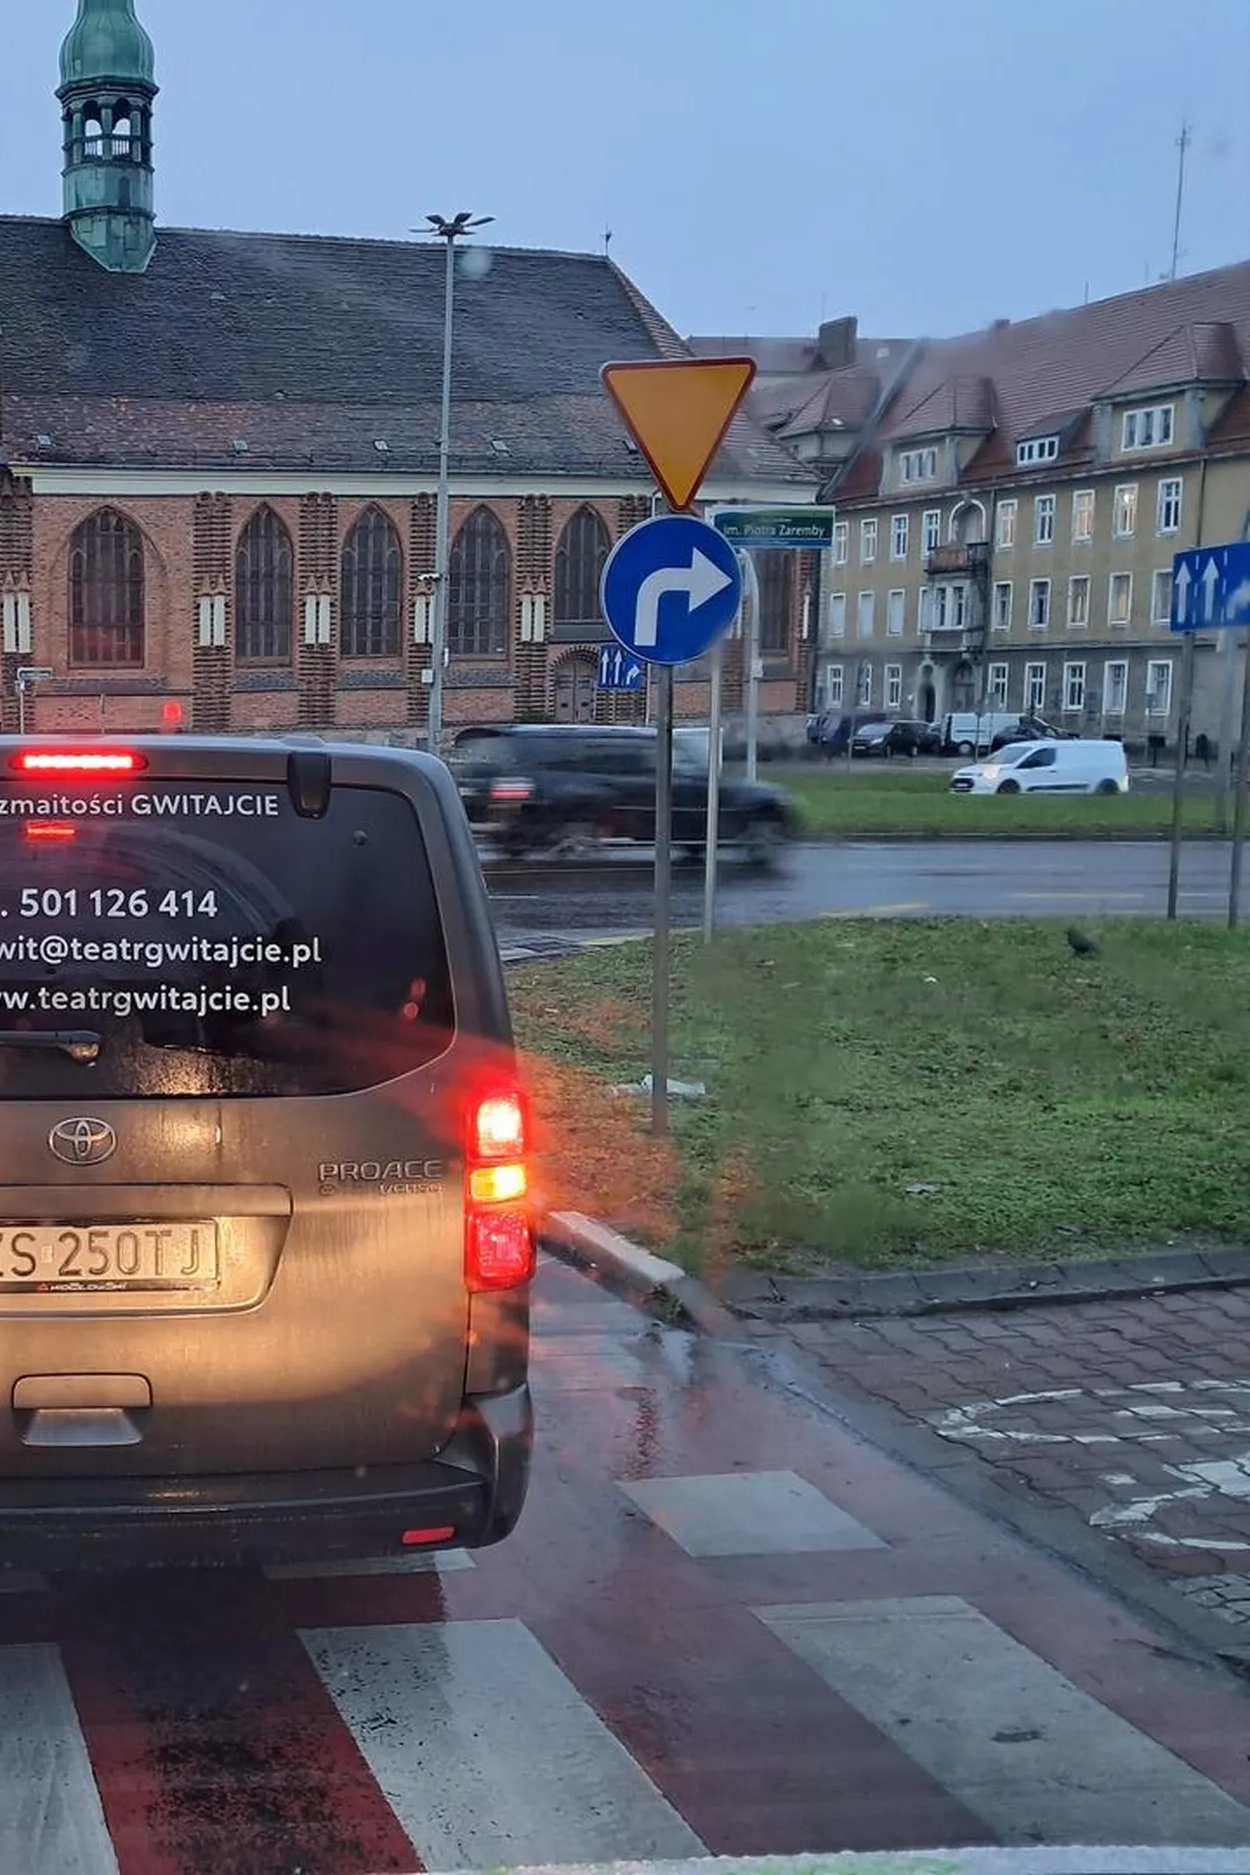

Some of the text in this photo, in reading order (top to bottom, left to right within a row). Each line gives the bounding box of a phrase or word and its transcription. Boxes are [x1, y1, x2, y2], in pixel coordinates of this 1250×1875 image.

[744, 524, 776, 536] Piotra
[778, 524, 825, 538] Zaremby
[131, 794, 279, 816] GWITAJCIE
[20, 888, 77, 917] 501
[89, 888, 148, 917] 126
[158, 889, 218, 918] 414
[318, 1160, 443, 1182] PROACE
[57, 1230, 200, 1277] 250TJ
